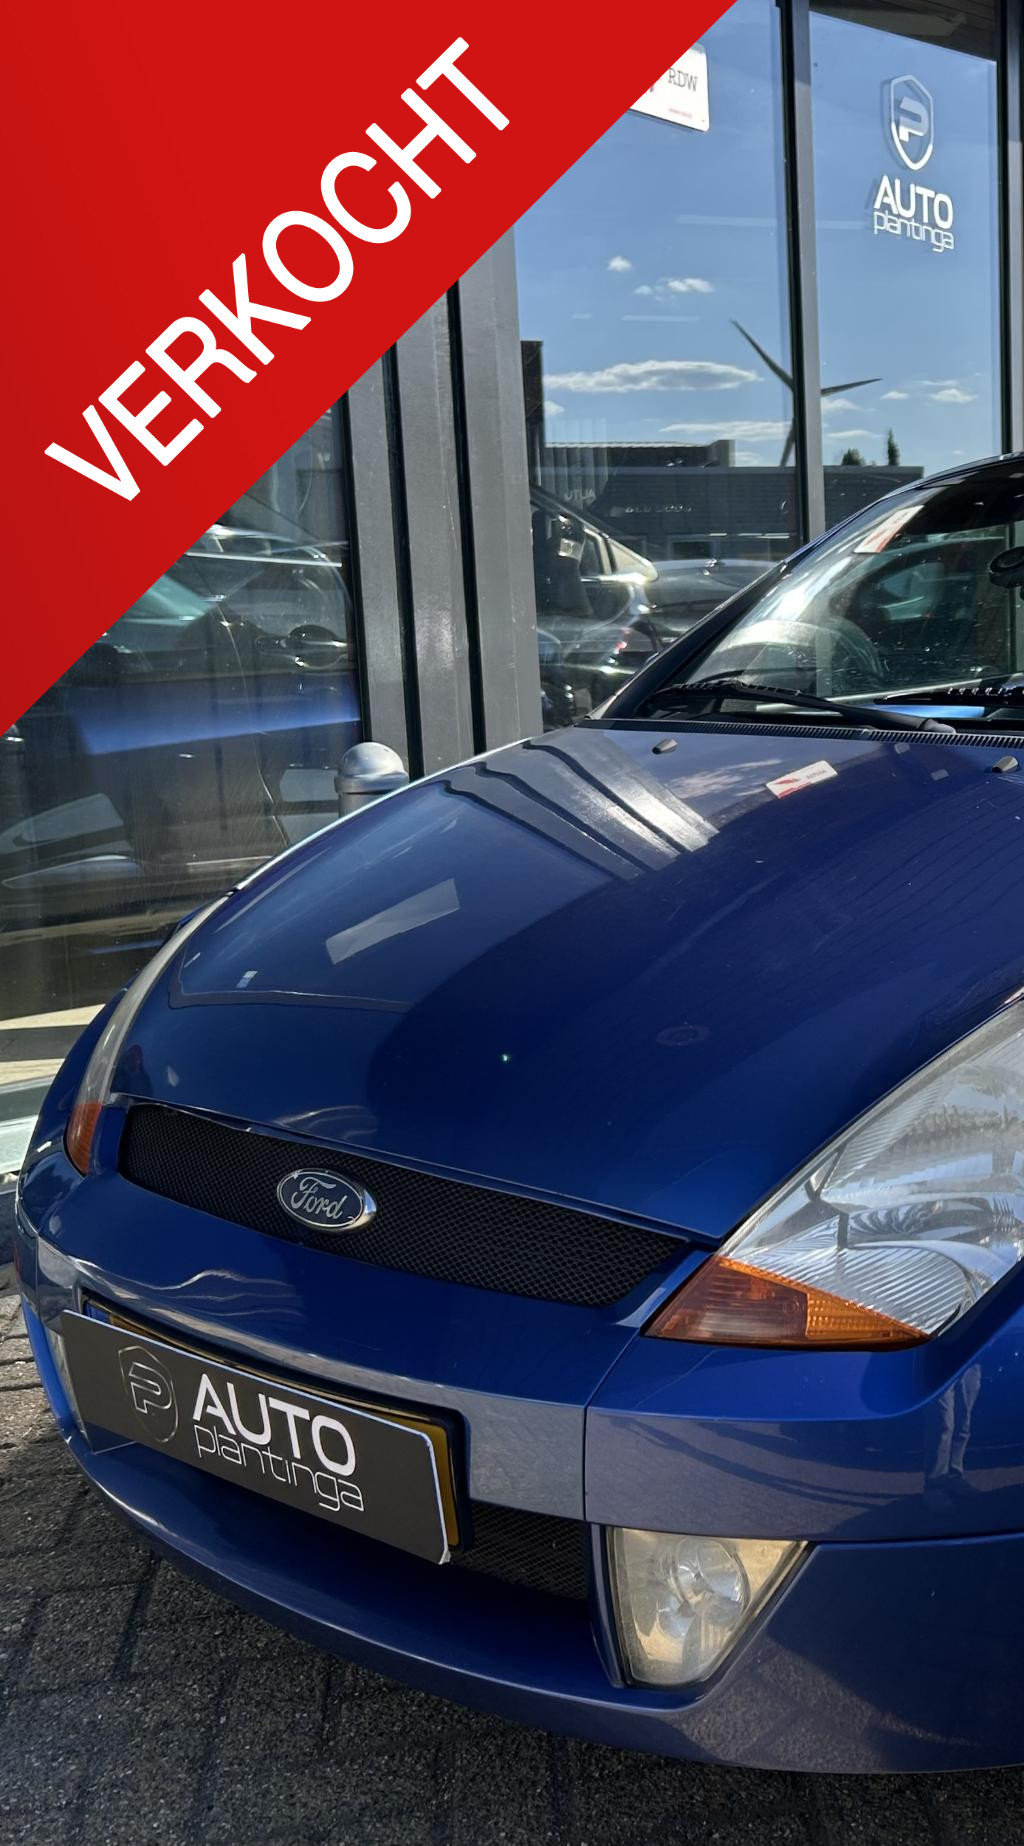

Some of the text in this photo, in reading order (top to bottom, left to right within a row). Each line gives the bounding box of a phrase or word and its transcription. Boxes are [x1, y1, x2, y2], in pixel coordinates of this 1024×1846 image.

[668, 67, 698, 92] RDW
[873, 175, 953, 229] AUTO
[873, 210, 954, 253] plantinga
[291, 1177, 348, 1219] Ford
[193, 1374, 356, 1477] AUTO
[193, 1425, 364, 1513] plantinga
